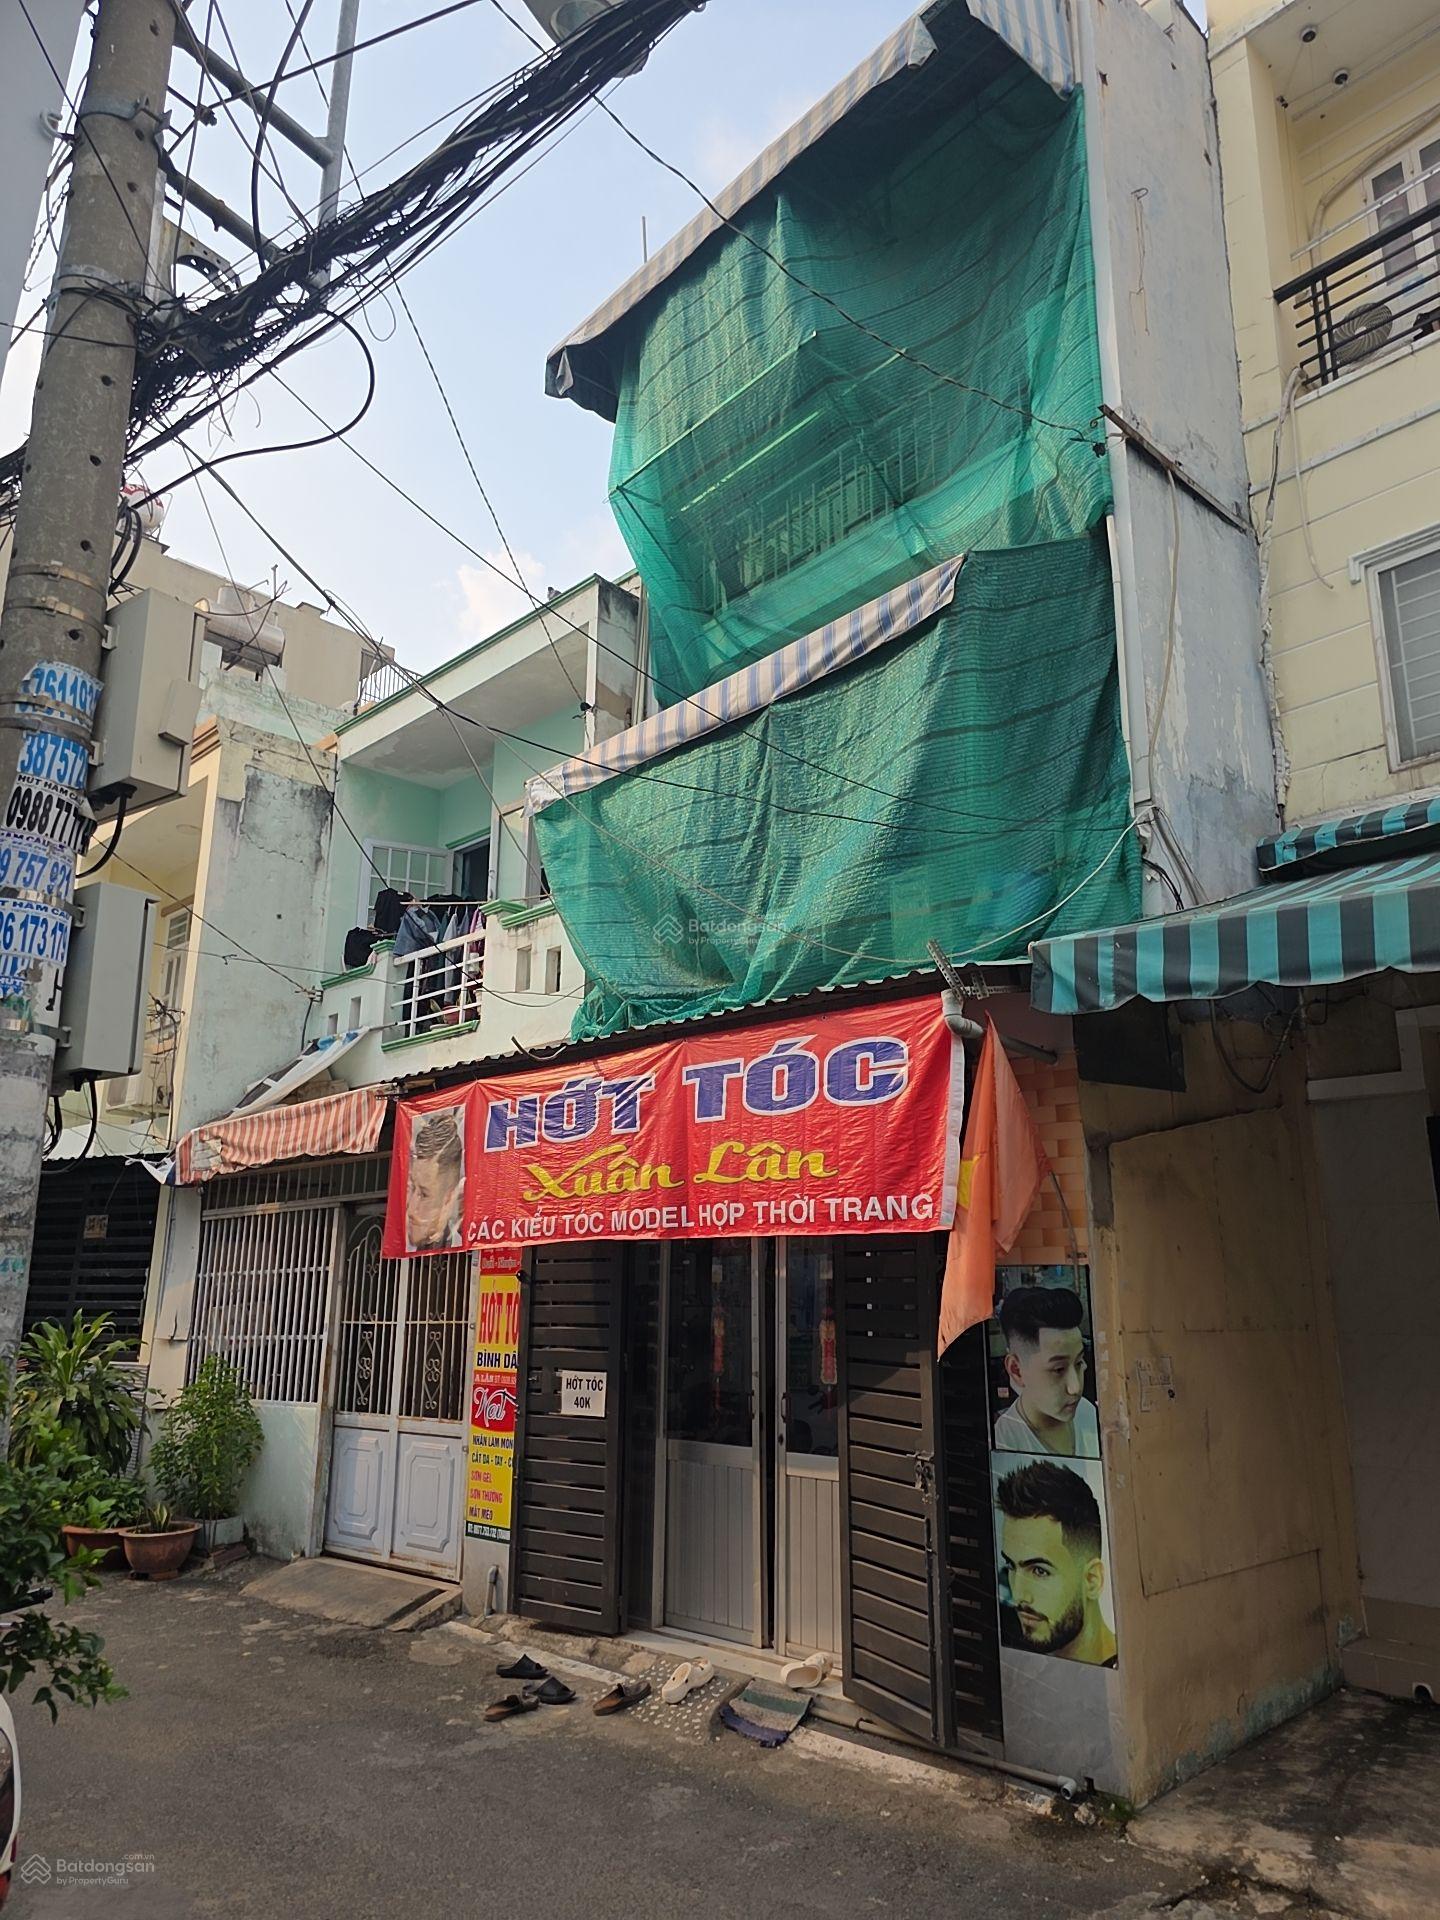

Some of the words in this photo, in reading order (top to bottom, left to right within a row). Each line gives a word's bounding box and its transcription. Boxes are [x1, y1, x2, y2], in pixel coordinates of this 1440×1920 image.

[484, 1075, 656, 1153] HỚT
[682, 1035, 909, 1124] TÓC
[522, 1144, 683, 1201] Xuân
[693, 1140, 839, 1185] Lân
[467, 1215, 505, 1243] CÁC
[511, 1206, 556, 1239] KIỂU
[562, 1208, 604, 1236] TÓC
[611, 1205, 695, 1232] MODEL
[699, 1200, 745, 1231] HỢP
[752, 1194, 816, 1226] THỜI
[823, 1193, 934, 1223] TRANG
[476, 1349, 501, 1369] BÌNH
[503, 1350, 520, 1370] DÂ
[566, 1375, 583, 1390] HỚT
[586, 1376, 604, 1391] TÓC
[574, 1396, 591, 1409] 40K
